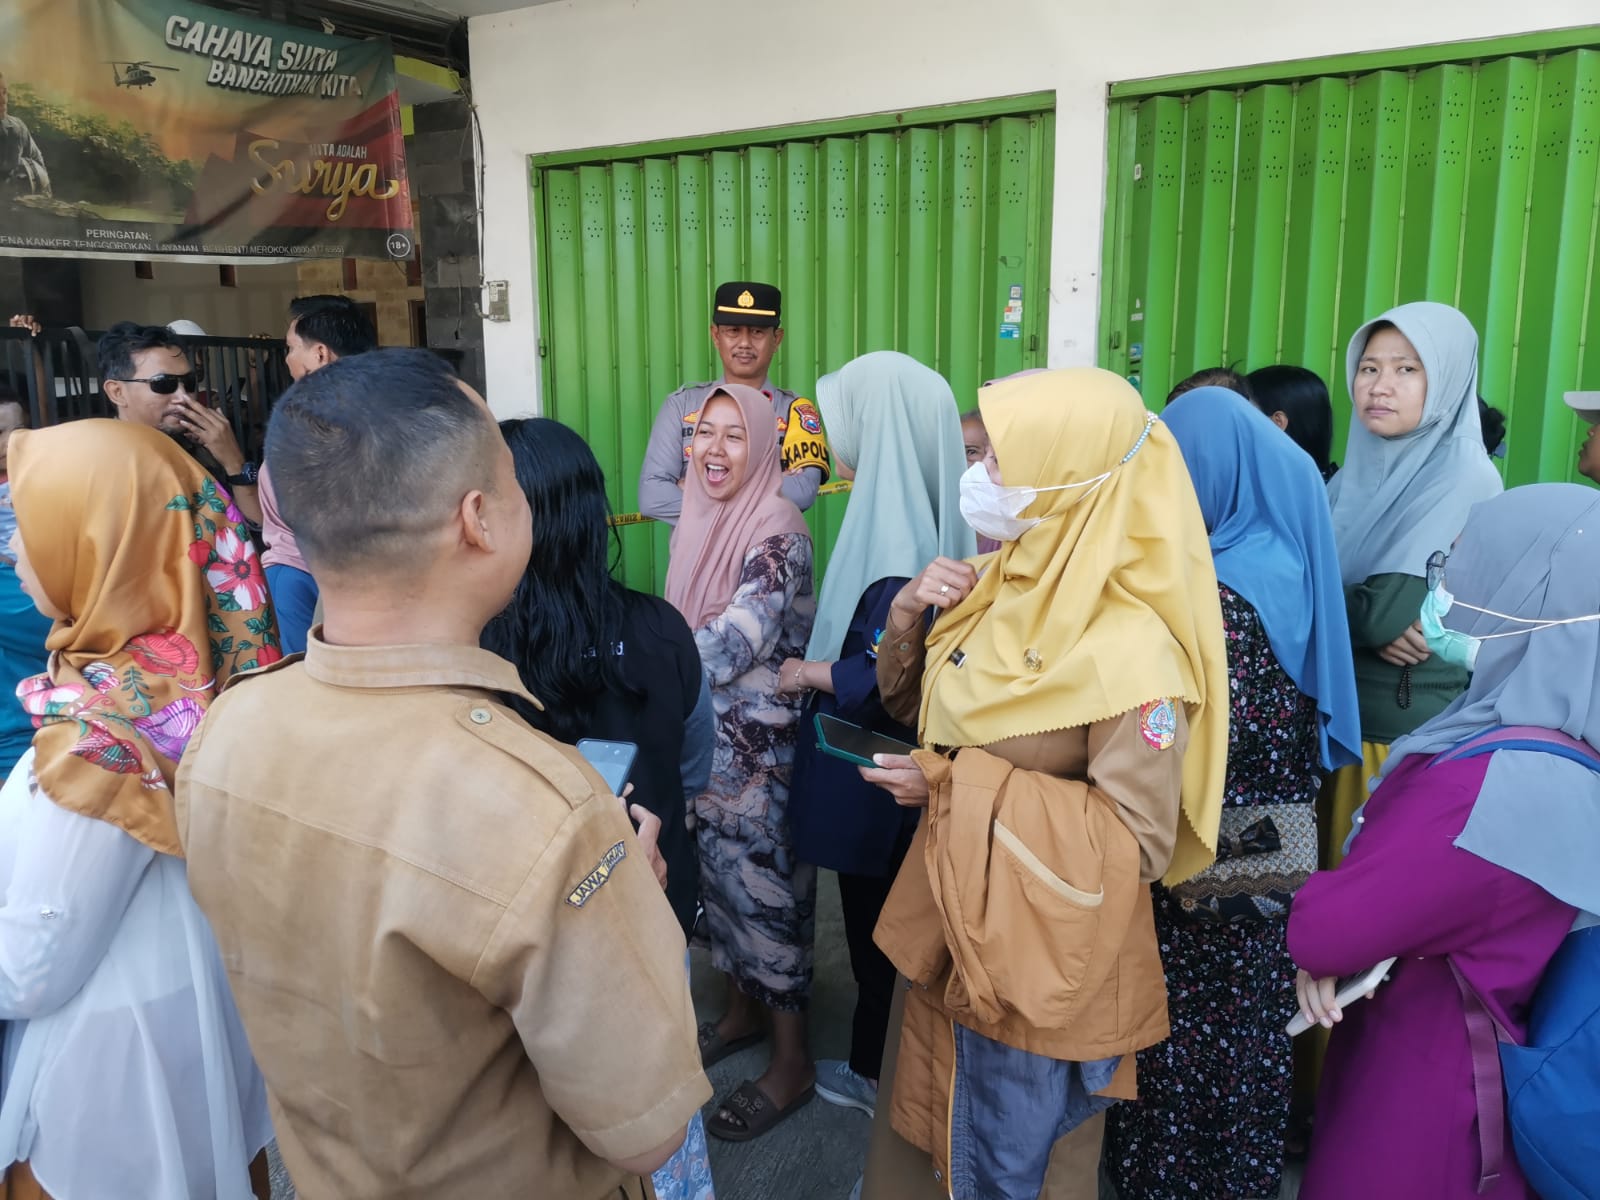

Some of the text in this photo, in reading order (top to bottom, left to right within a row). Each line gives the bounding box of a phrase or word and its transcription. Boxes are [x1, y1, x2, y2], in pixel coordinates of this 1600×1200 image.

[165, 15, 273, 68] CAHAYA
[321, 74, 363, 96] KITA
[335, 144, 368, 160] ADALAH
[248, 139, 400, 221] Surya
[26, 237, 71, 248] KANKER
[249, 244, 289, 254] MEROKOK
[86, 228, 152, 241] PERINGATAN:
[391, 241, 406, 250] 18+
[785, 441, 828, 465] KAPOL
[574, 870, 607, 903] JAWA
